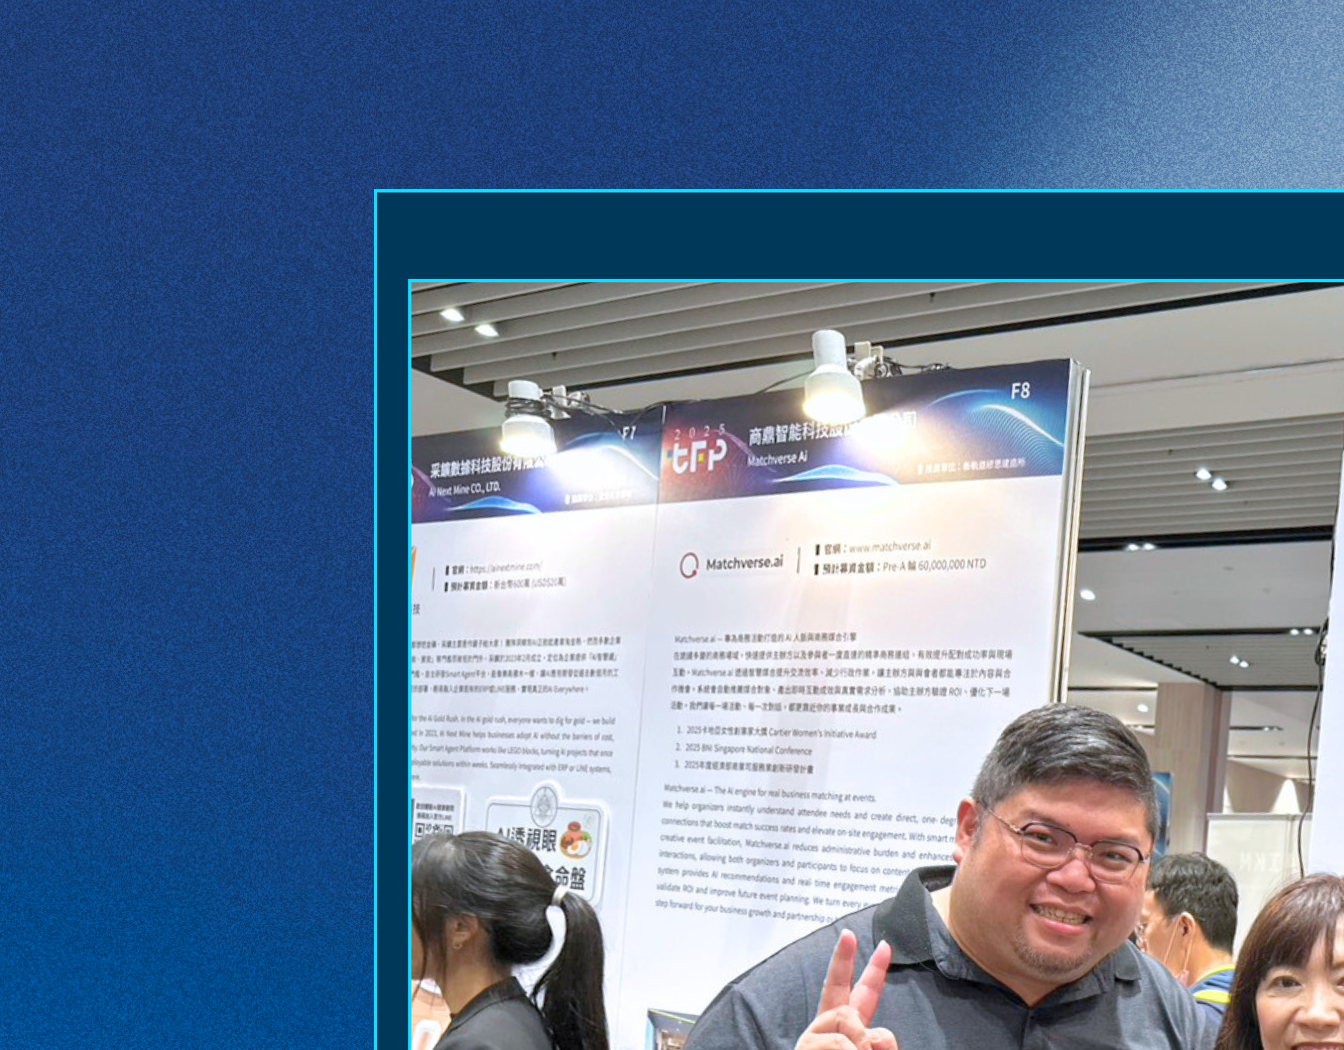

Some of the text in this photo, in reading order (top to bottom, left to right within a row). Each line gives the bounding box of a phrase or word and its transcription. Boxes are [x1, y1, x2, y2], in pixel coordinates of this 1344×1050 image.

[1010, 382, 1030, 399] F8
[674, 423, 726, 441] 2025
[747, 452, 796, 468] Matchverse
[453, 484, 470, 495] Mine
[706, 554, 784, 572] Matchverse.ai
[967, 558, 987, 569] NTD
